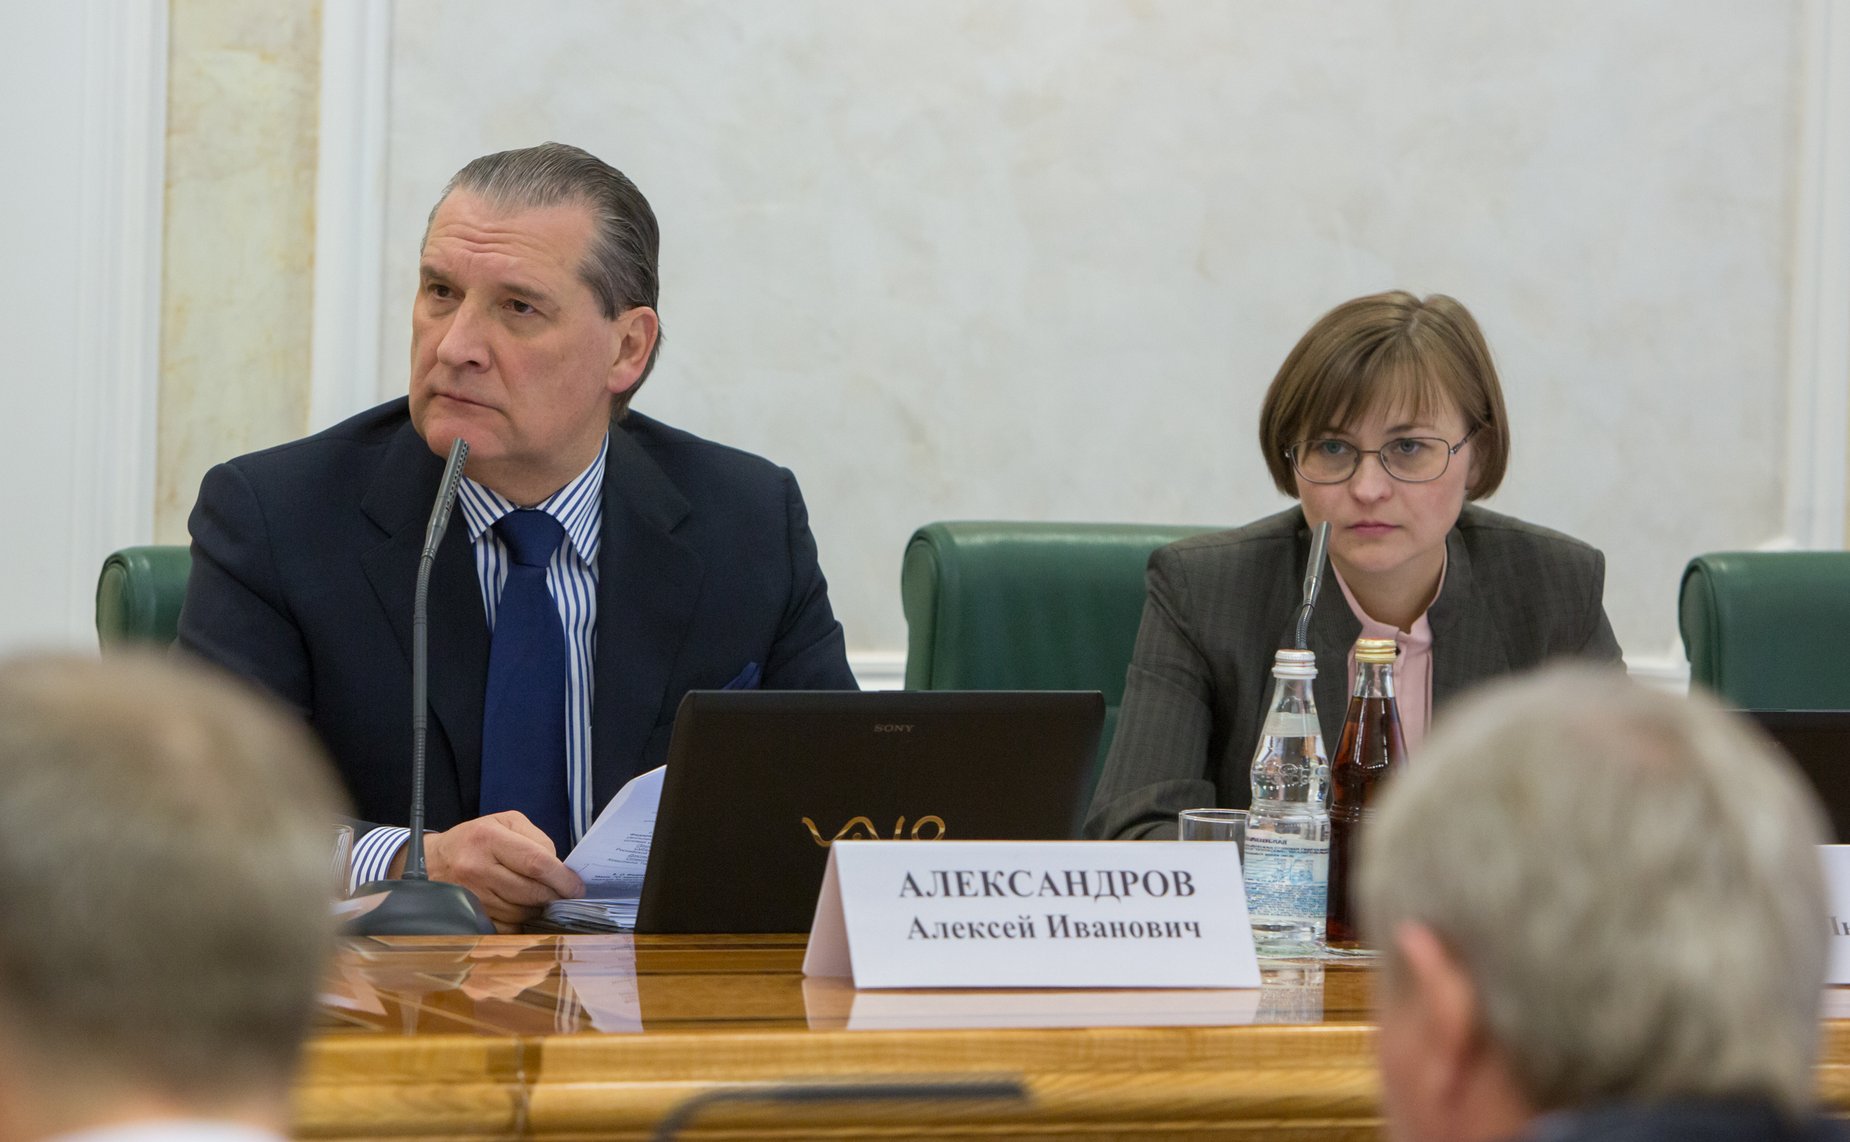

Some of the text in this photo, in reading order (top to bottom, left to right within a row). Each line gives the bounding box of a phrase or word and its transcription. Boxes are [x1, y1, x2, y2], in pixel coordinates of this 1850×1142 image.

[873, 724, 915, 733] SONY
[899, 869, 1197, 903] АЛЕКСАНДРОВ
[907, 914, 1203, 940] Алексей Иванович
